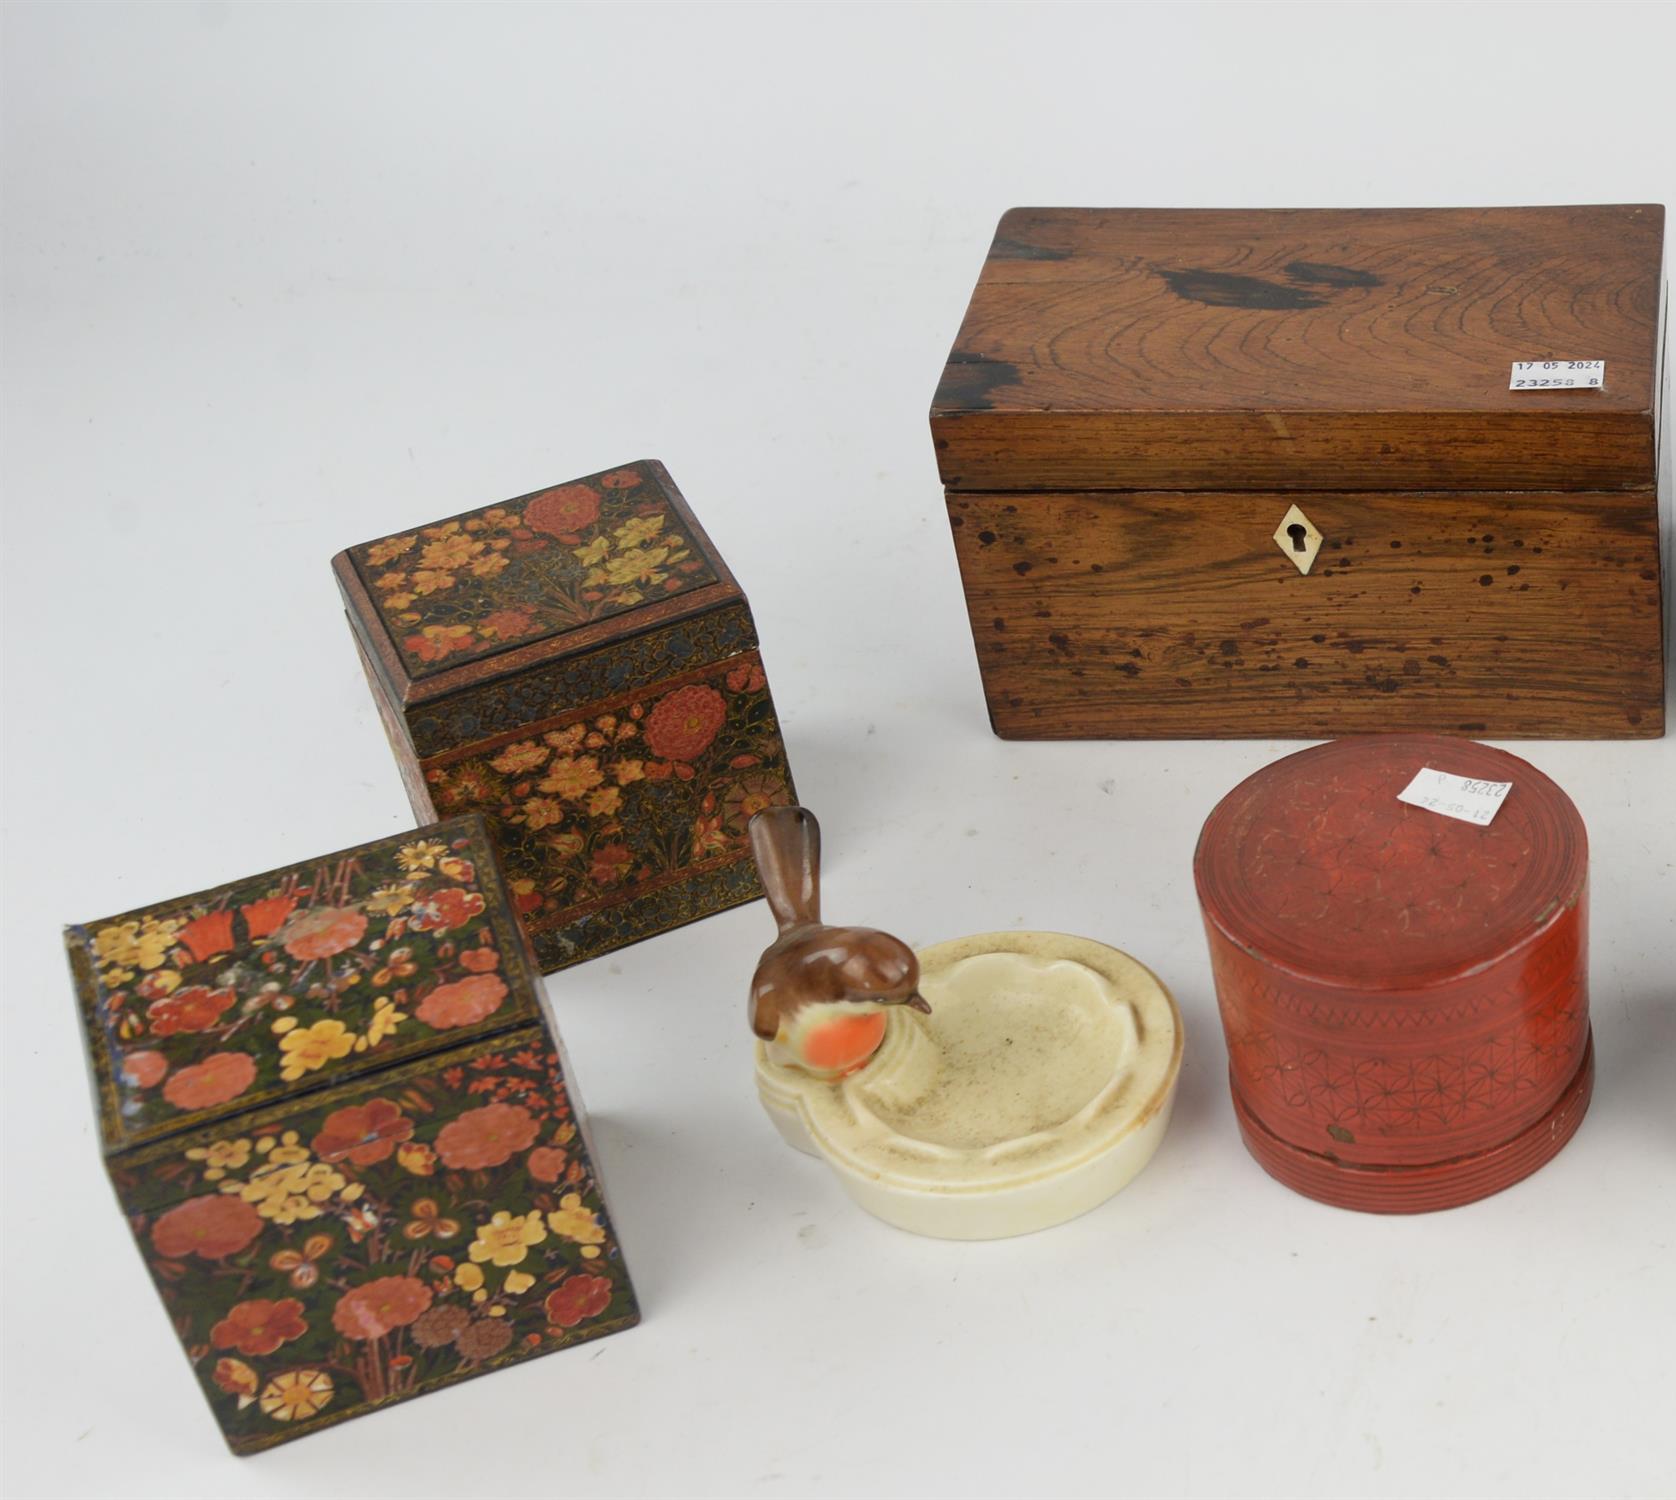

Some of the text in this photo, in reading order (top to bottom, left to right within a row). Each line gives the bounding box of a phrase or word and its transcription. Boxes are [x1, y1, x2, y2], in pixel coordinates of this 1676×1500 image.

[1518, 361, 1600, 370] 17 05 2024
[1516, 379, 1574, 387] 23258
[1461, 780, 1506, 797] 23258
